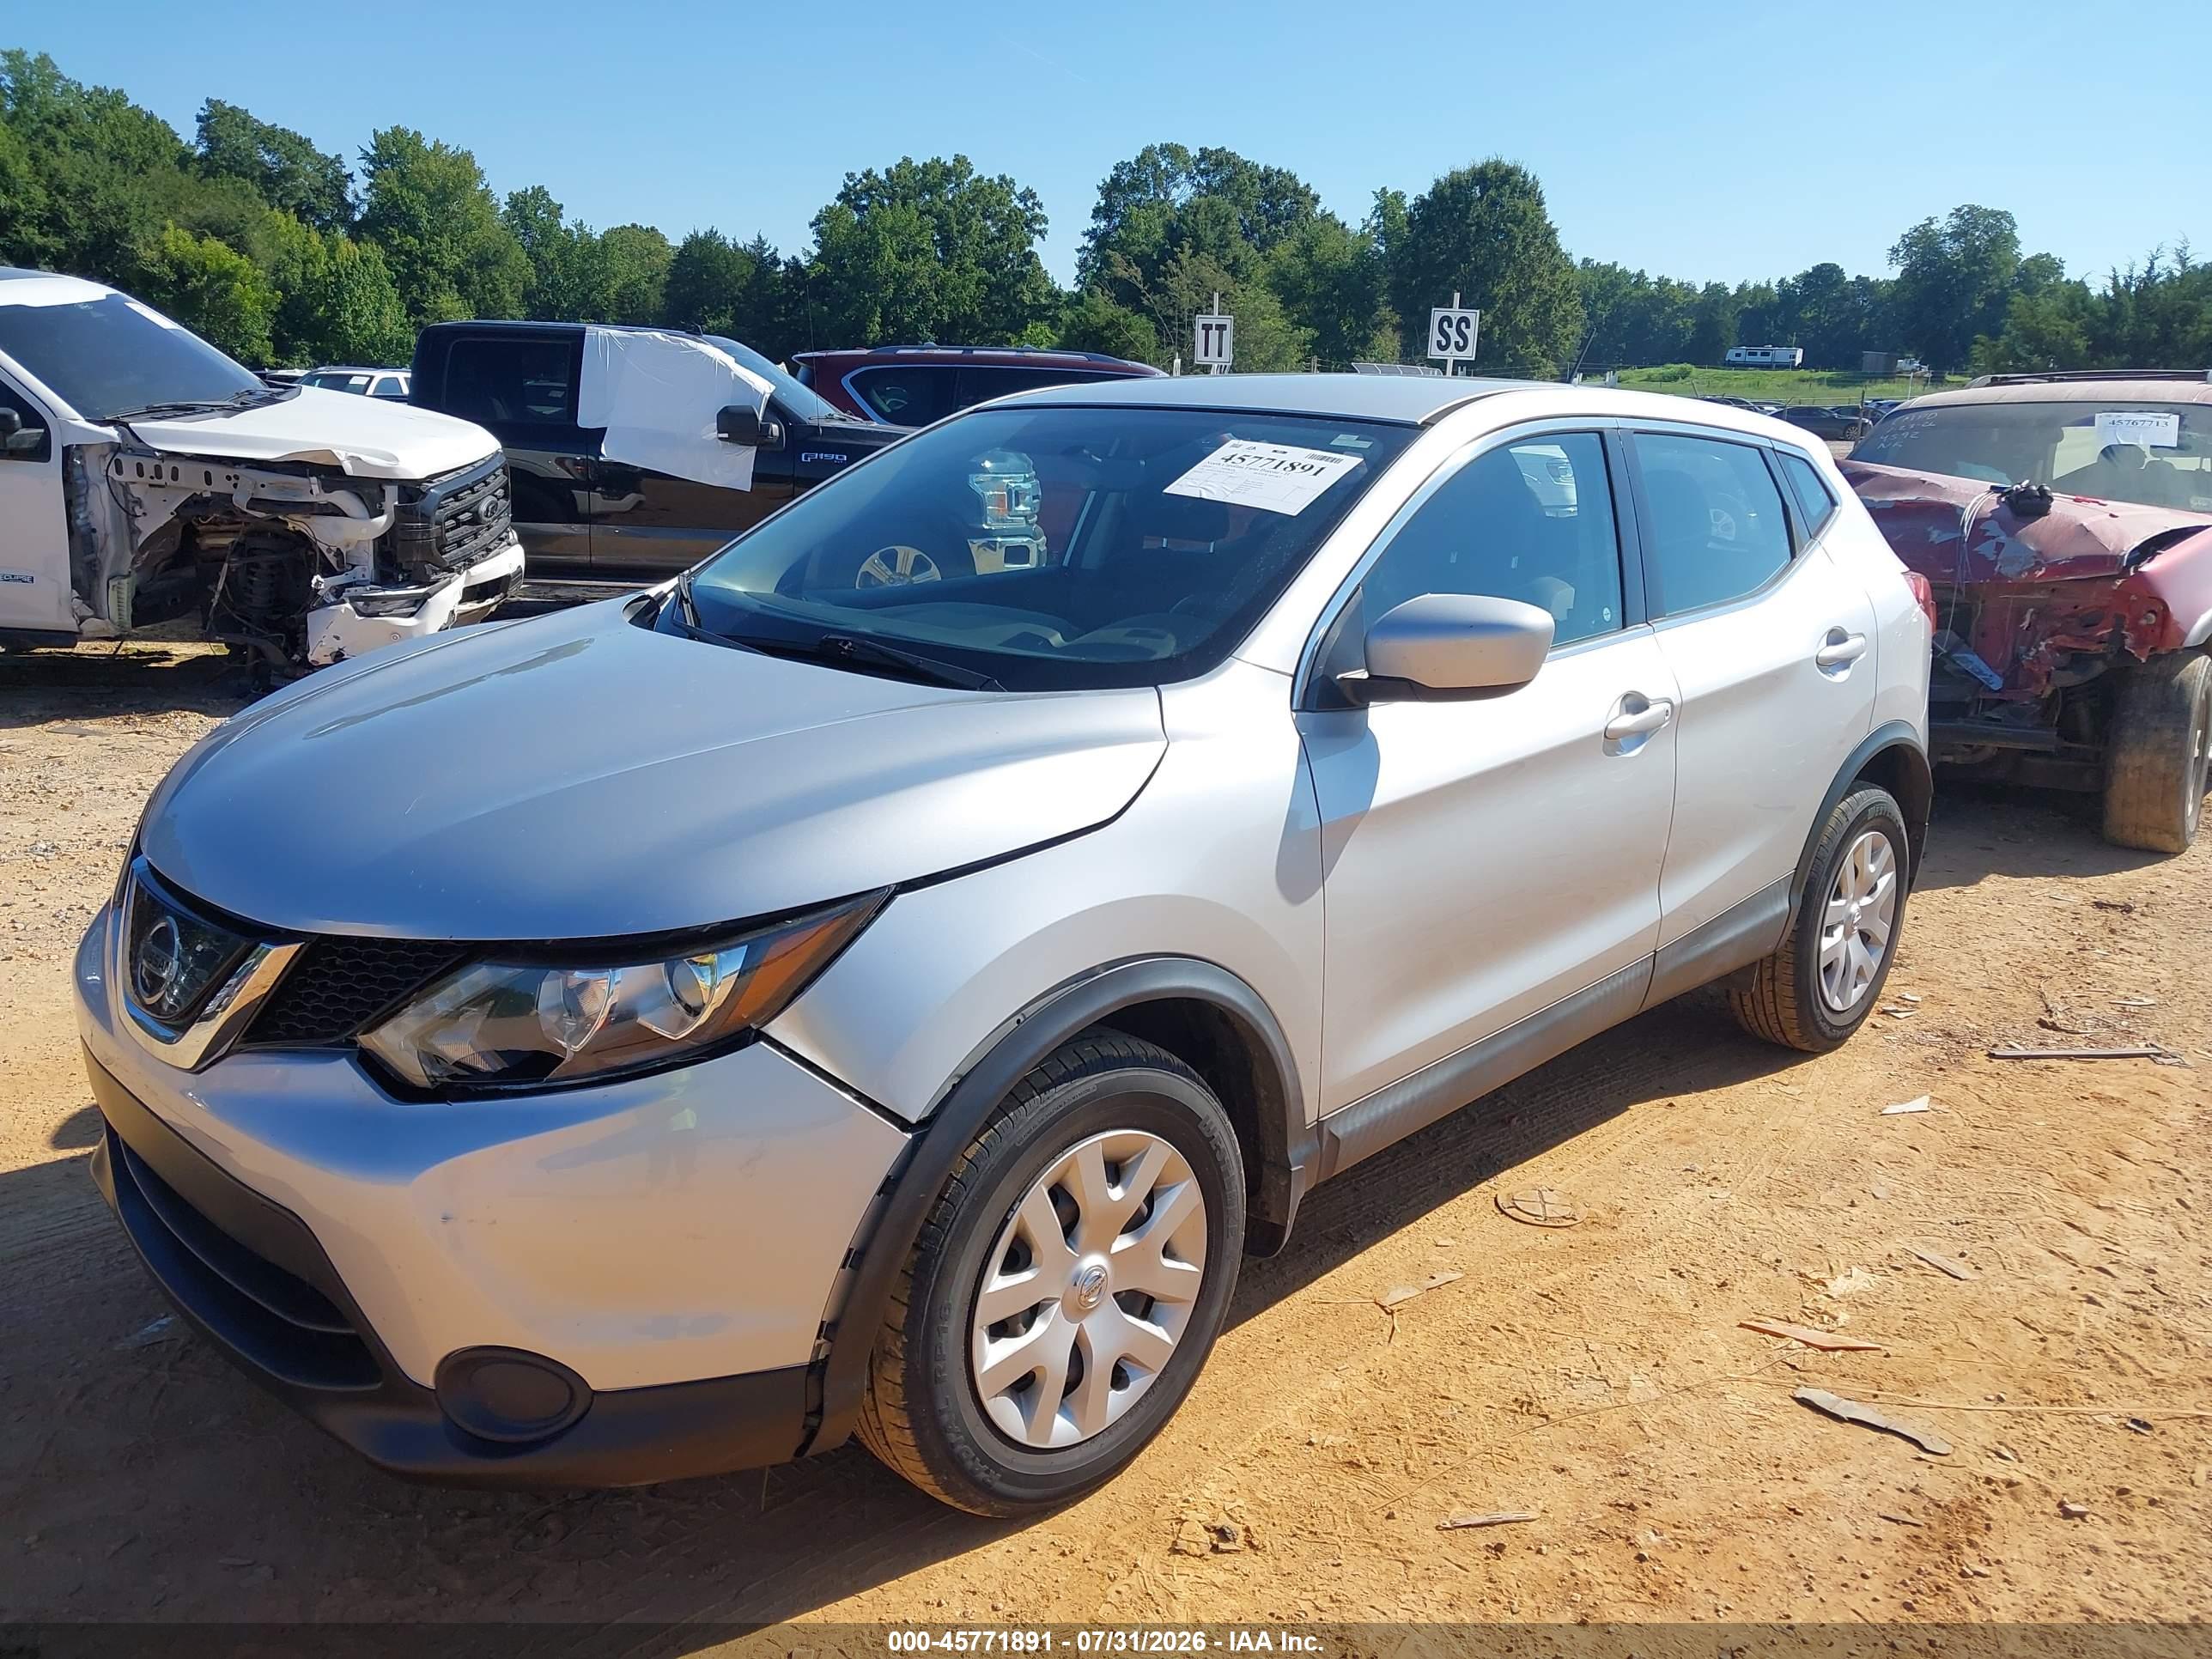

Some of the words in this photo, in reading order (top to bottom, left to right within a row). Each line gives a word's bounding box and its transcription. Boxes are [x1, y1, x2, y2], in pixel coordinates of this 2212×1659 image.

[1201, 323, 1227, 357] TT
[1436, 314, 1471, 352] SS
[1221, 453, 1327, 477] 45771891
